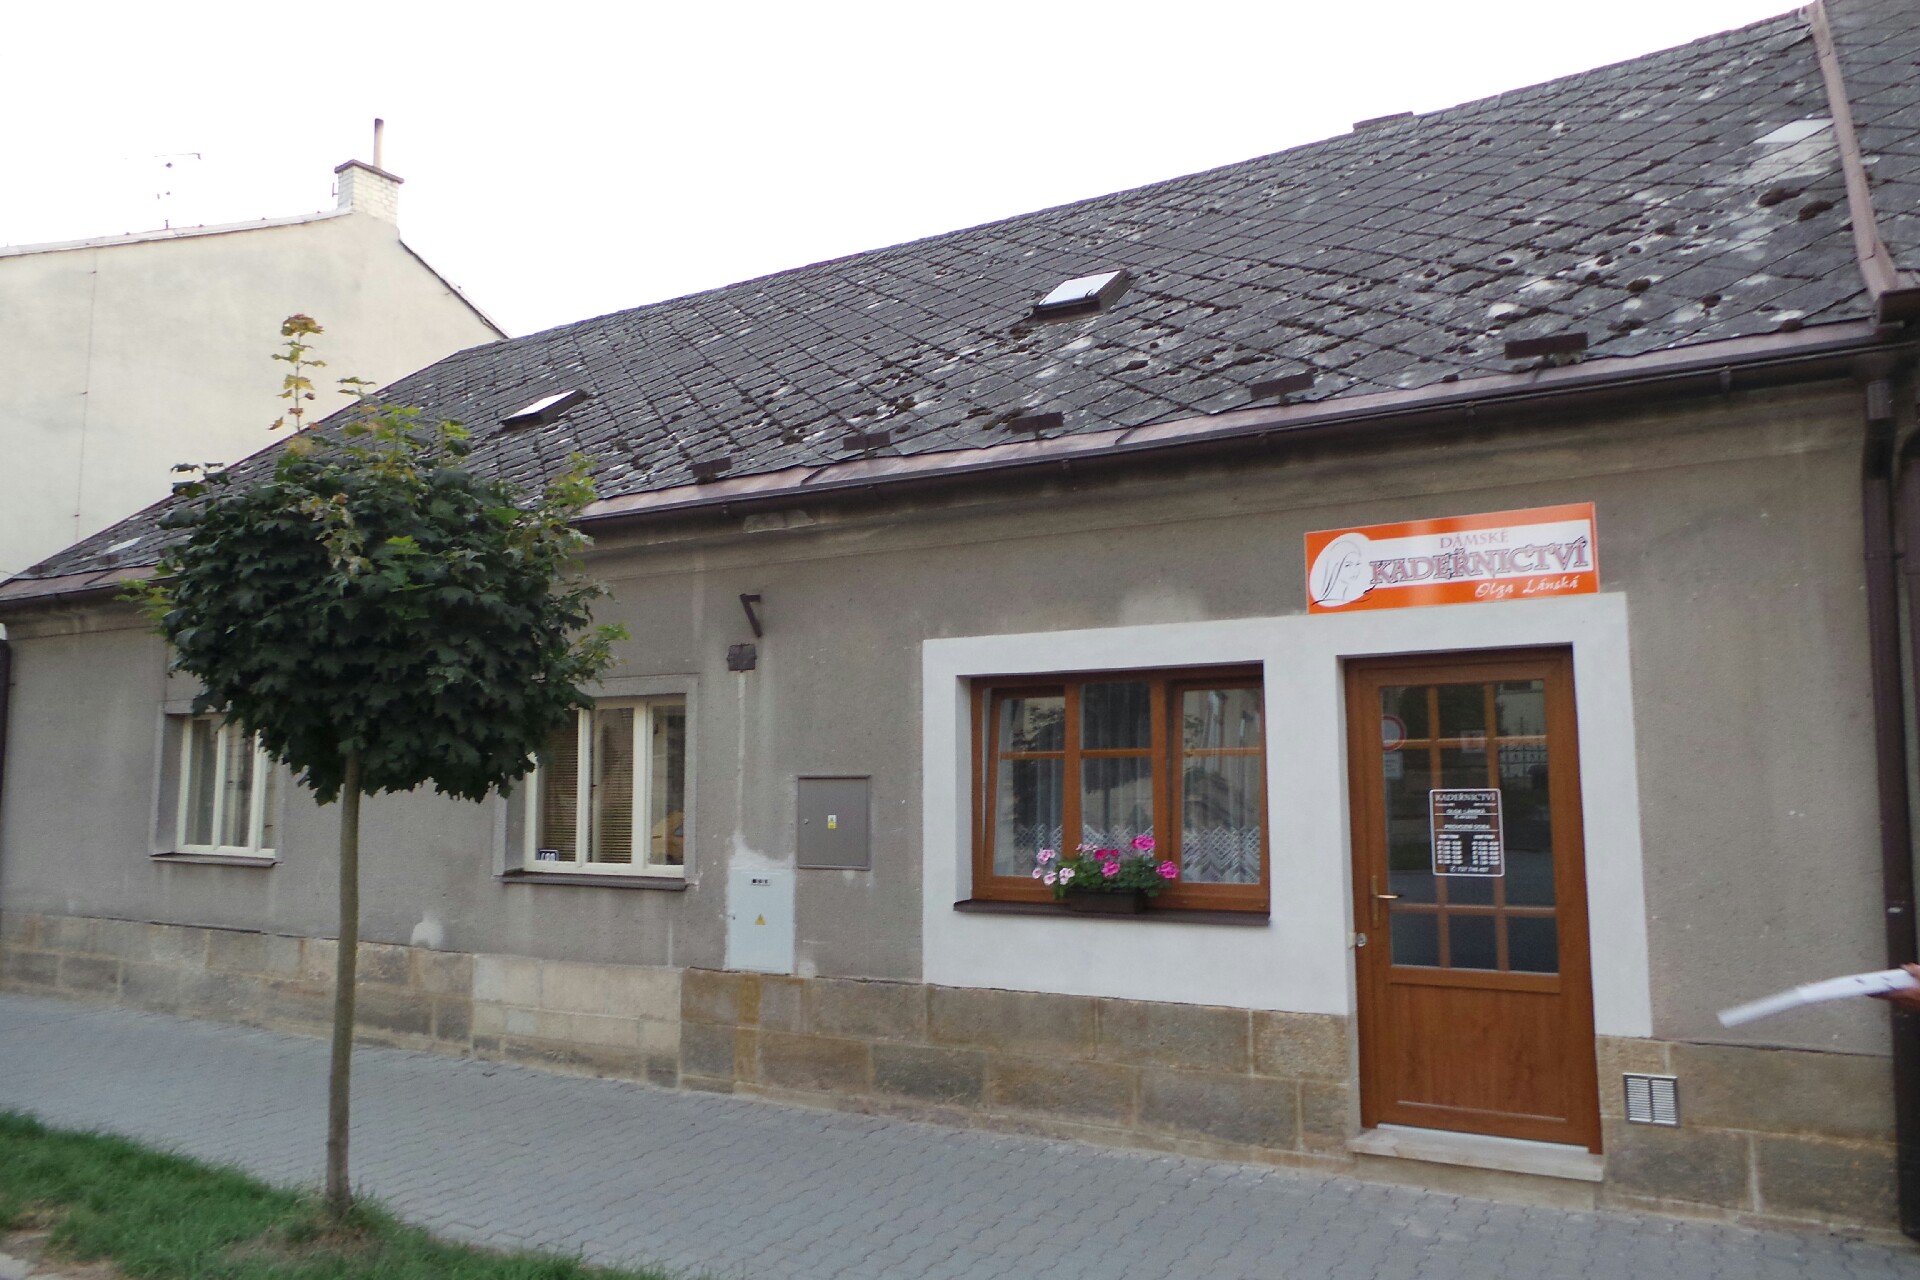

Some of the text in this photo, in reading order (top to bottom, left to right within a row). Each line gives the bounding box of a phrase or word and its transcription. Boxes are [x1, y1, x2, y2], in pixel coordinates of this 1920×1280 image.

[1440, 530, 1509, 548] DÁMSKÉ
[1370, 535, 1589, 585] KADEŘNICTVÍ
[1474, 574, 1581, 599] Olga Lánská
